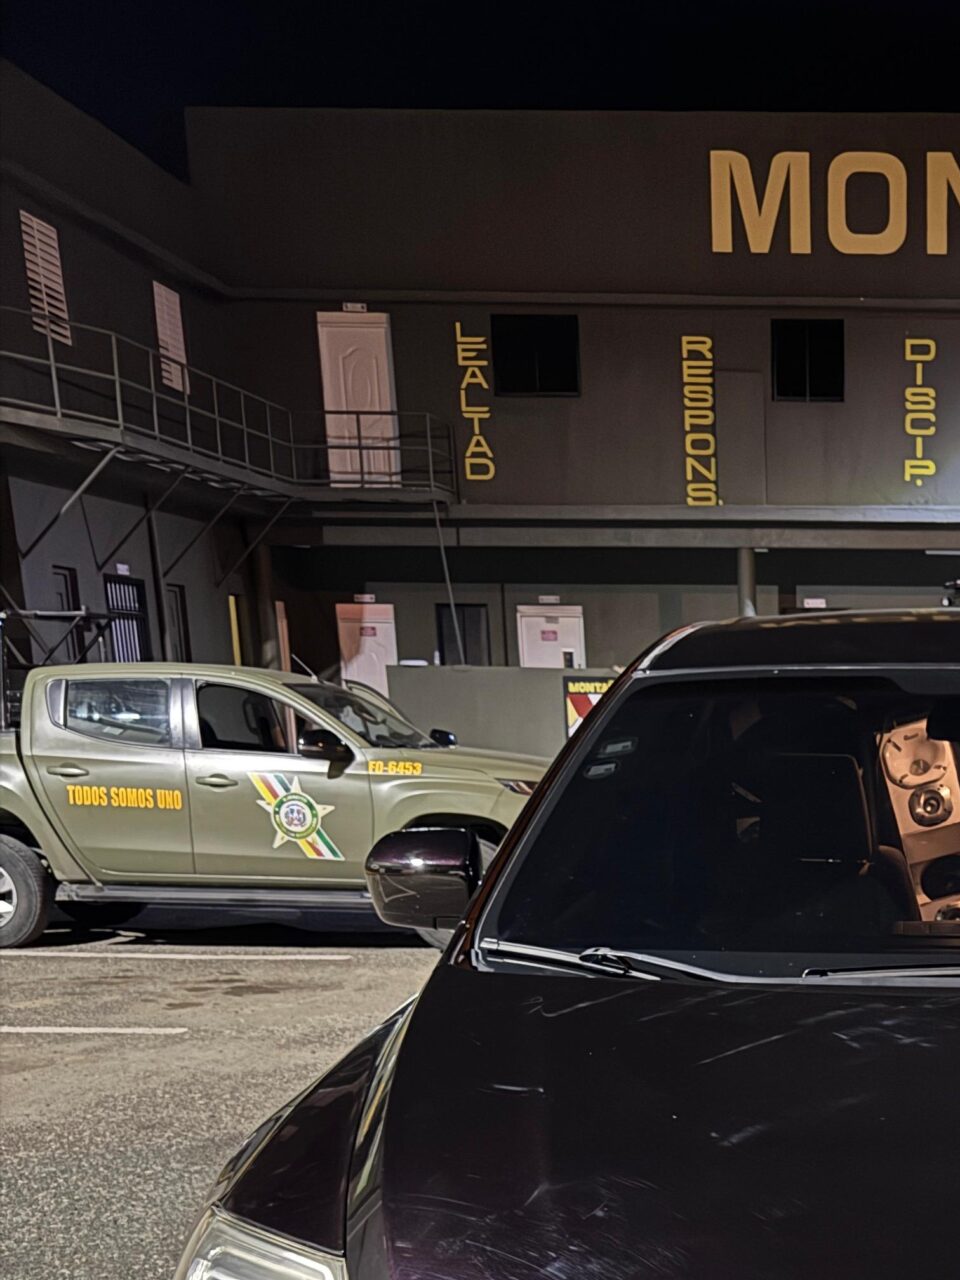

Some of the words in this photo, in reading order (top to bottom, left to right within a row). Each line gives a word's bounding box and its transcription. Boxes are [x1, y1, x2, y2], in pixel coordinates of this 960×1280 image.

[455, 322, 495, 480] LEALTAD
[681, 336, 724, 506] RESPONS.
[904, 338, 936, 486] DISCIP.
[66, 785, 108, 806] TODOS
[110, 787, 154, 809] SOMOS
[156, 789, 182, 810] UNO
